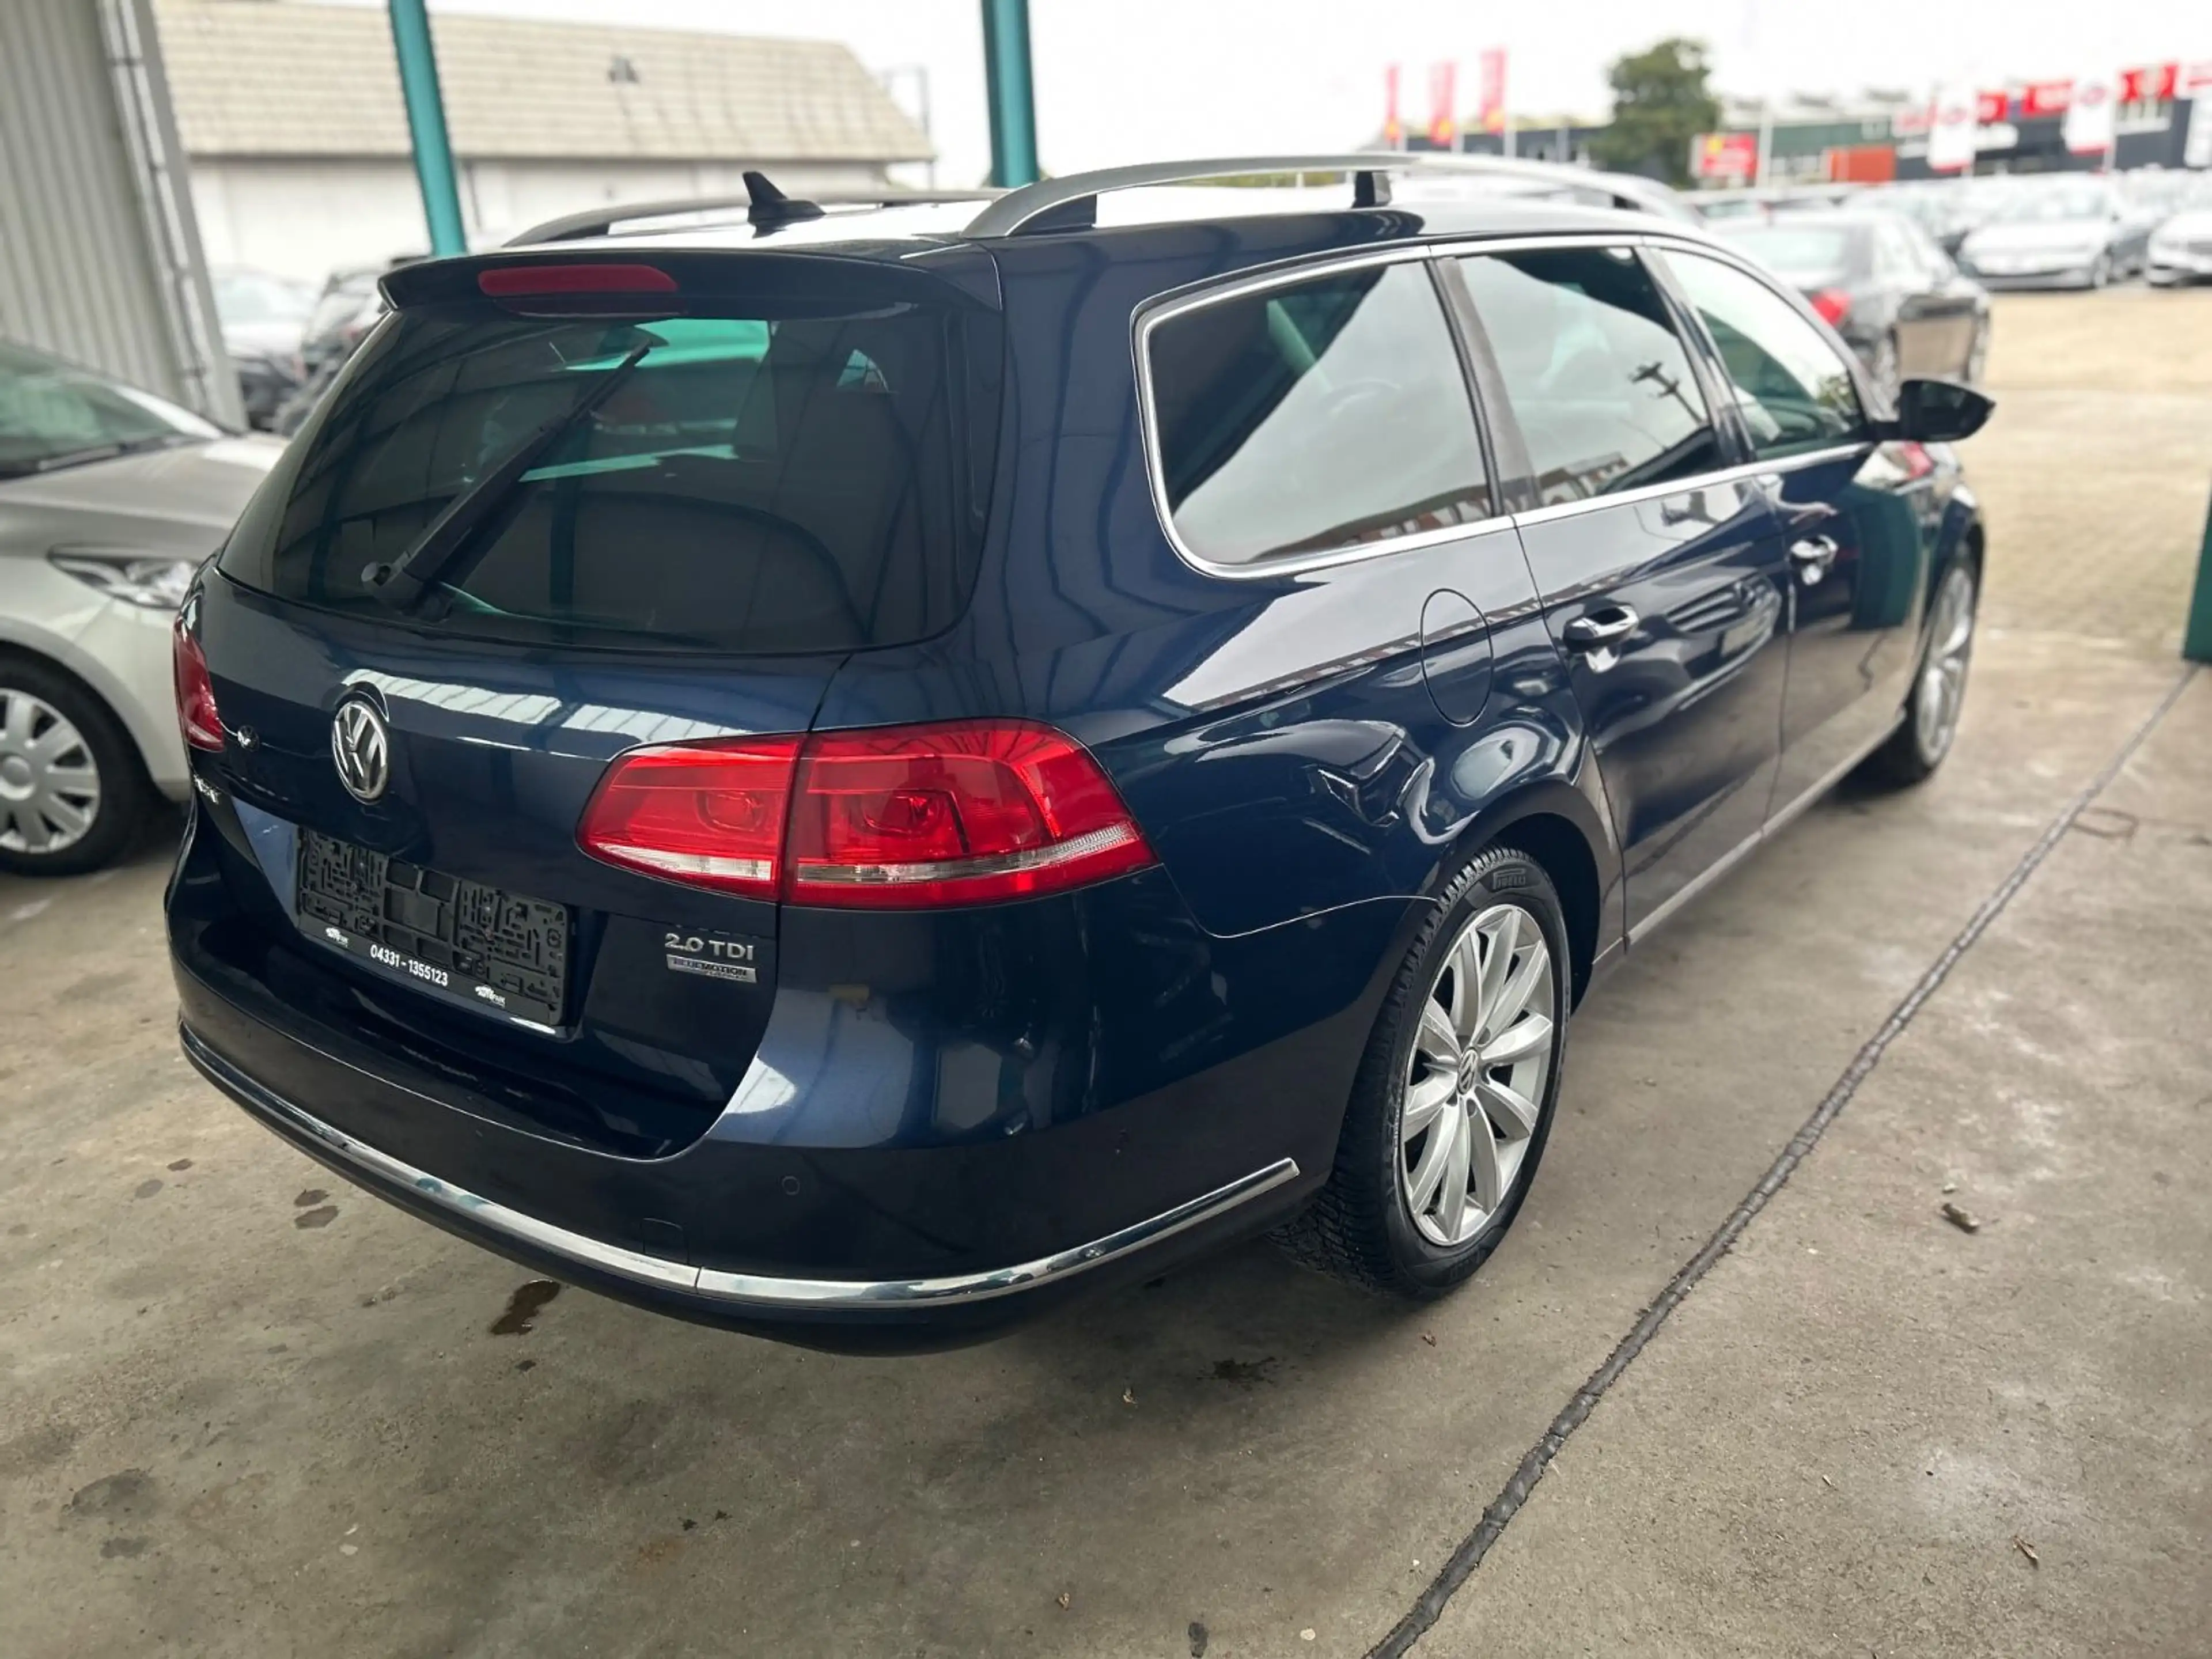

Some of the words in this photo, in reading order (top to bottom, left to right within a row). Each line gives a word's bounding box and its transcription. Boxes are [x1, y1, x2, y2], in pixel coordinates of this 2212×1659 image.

[665, 933, 704, 952] 2.0
[708, 940, 754, 960] TDI
[370, 944, 400, 967] 04331
[408, 959, 448, 986] 1355123
